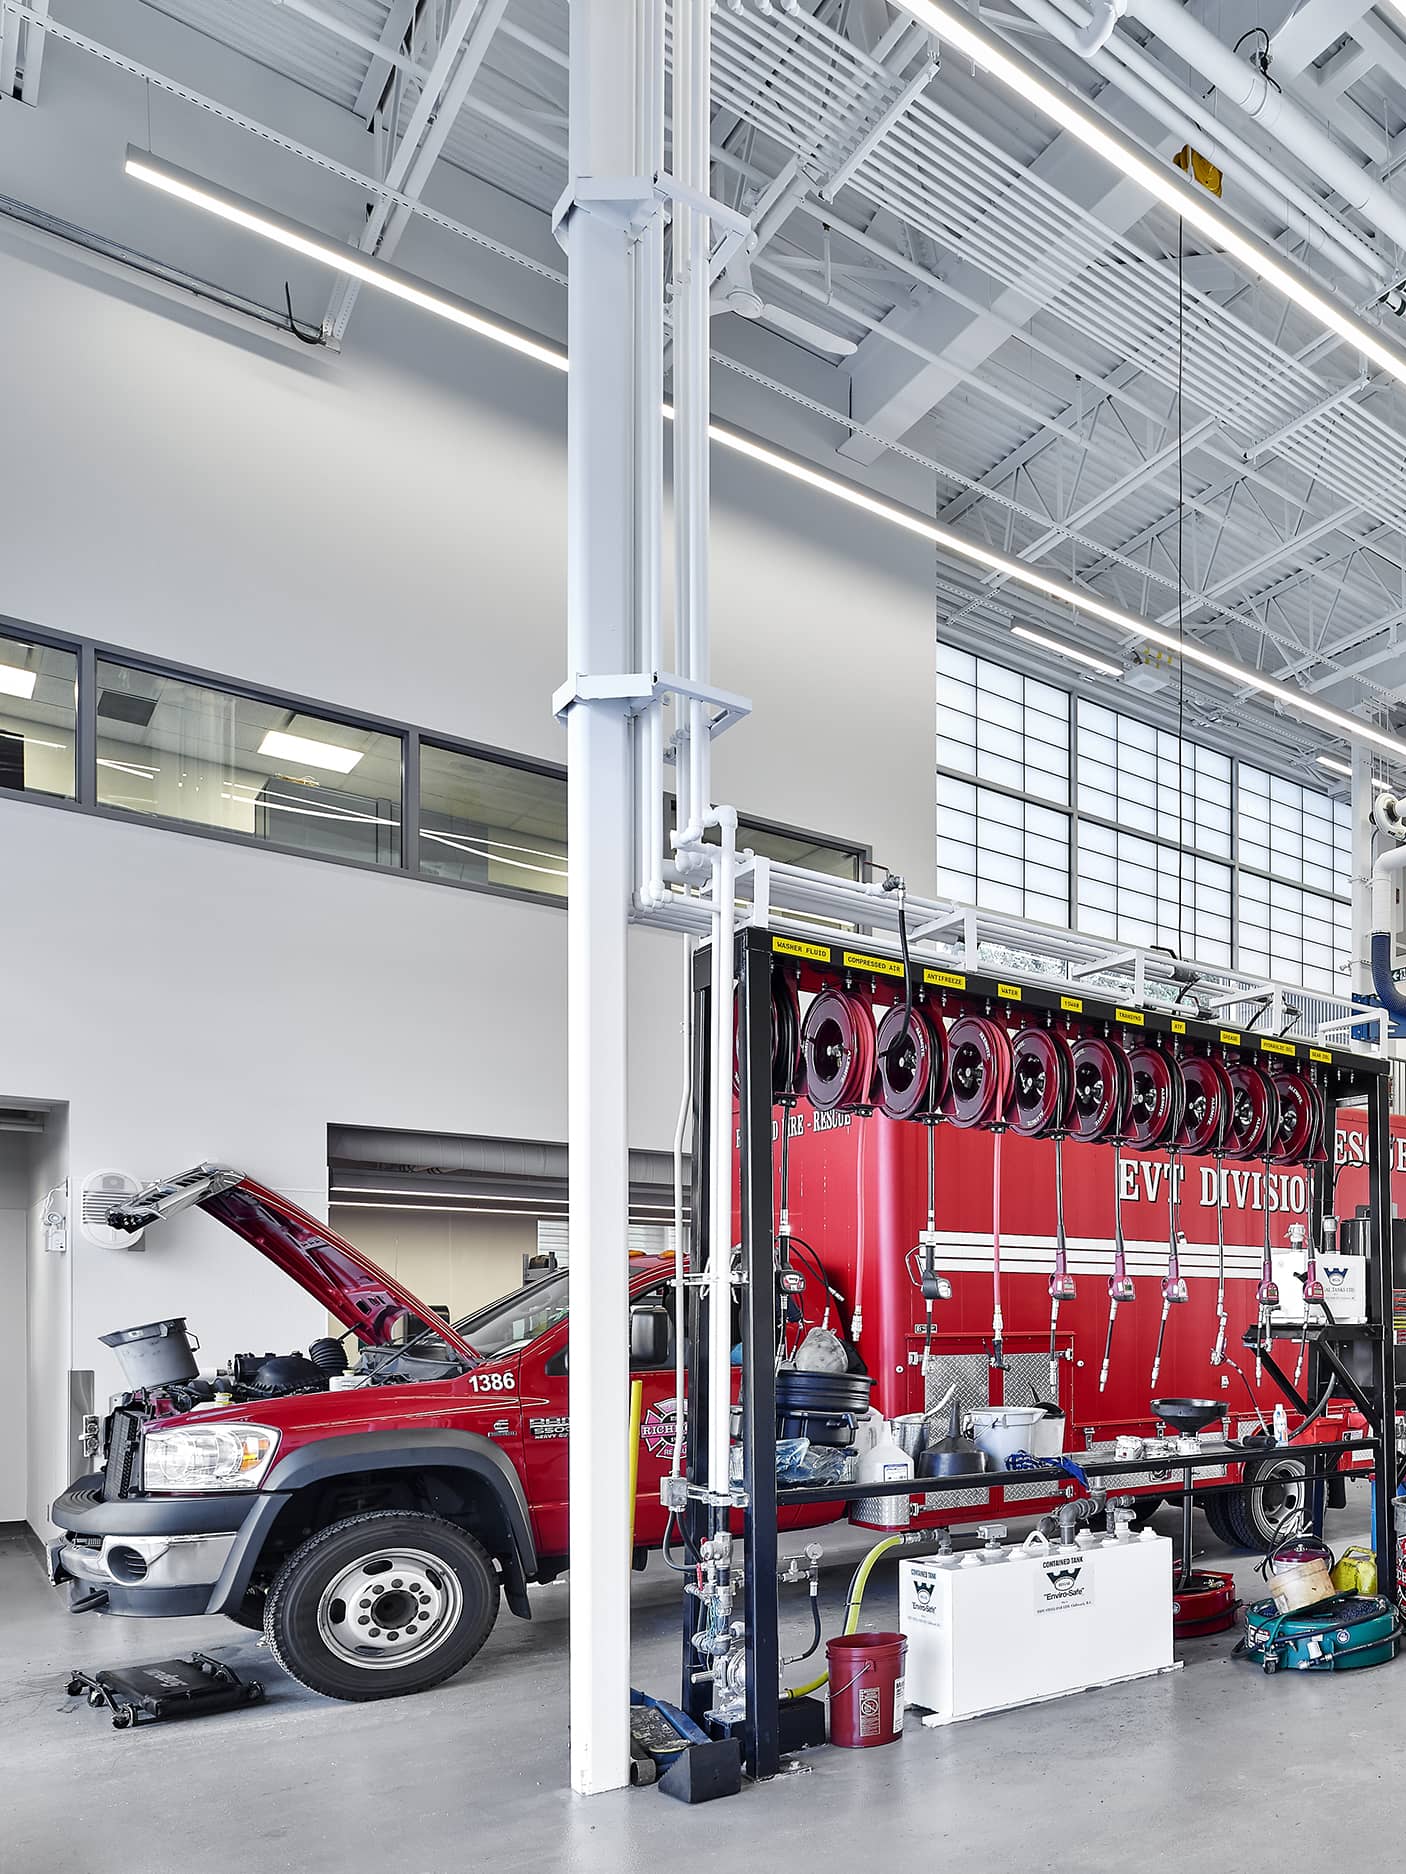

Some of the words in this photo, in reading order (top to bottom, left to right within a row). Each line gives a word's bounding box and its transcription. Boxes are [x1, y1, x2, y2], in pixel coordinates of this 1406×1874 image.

[776, 941, 802, 953] WASHER
[805, 946, 827, 958] FLUID
[847, 956, 887, 970] COMPRESSED
[888, 964, 901, 973] AIR
[927, 972, 962, 986] ANTIFREEZE
[1001, 987, 1018, 996] WATER
[1119, 1158, 1185, 1204] EVT
[468, 1372, 516, 1393] 1386
[1042, 1557, 1071, 1569] CONTAINED
[1071, 1556, 1084, 1564] TANK
